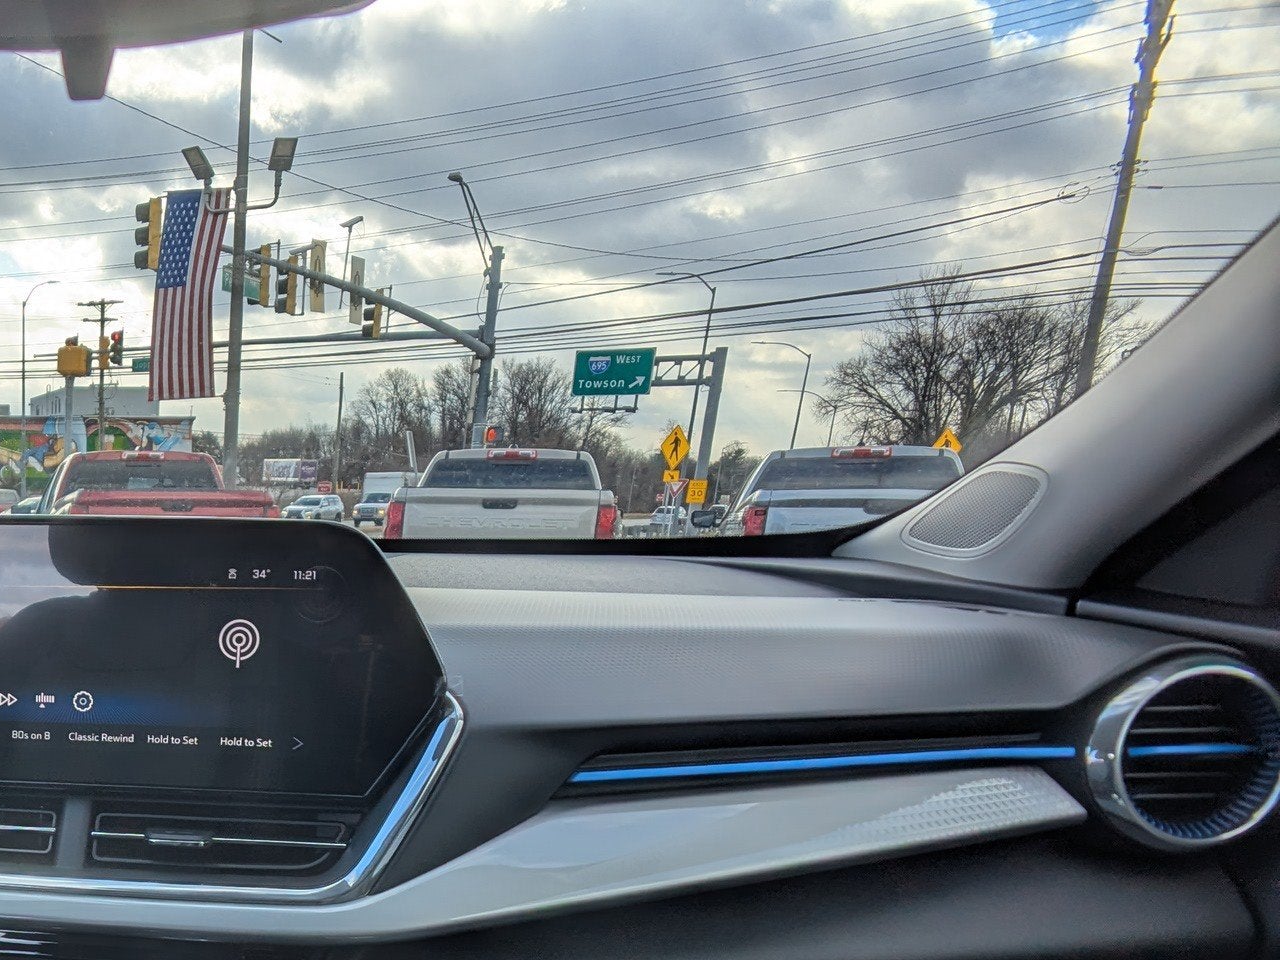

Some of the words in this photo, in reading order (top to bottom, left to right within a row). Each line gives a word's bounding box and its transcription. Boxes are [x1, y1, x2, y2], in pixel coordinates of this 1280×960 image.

[591, 361, 607, 370] 695
[690, 489, 703, 497] 30
[424, 516, 578, 530] CHEVROLET
[293, 569, 317, 580] 11:21
[11, 730, 29, 740] 80s
[31, 732, 42, 740] on
[44, 731, 51, 740] 8
[68, 731, 100, 742] Classic
[101, 733, 135, 743] Rewind
[147, 734, 169, 745] Hold
[171, 736, 181, 745] to
[182, 735, 198, 745] Set
[220, 736, 242, 747] Hold
[244, 738, 255, 747] to
[256, 738, 272, 747] Set
